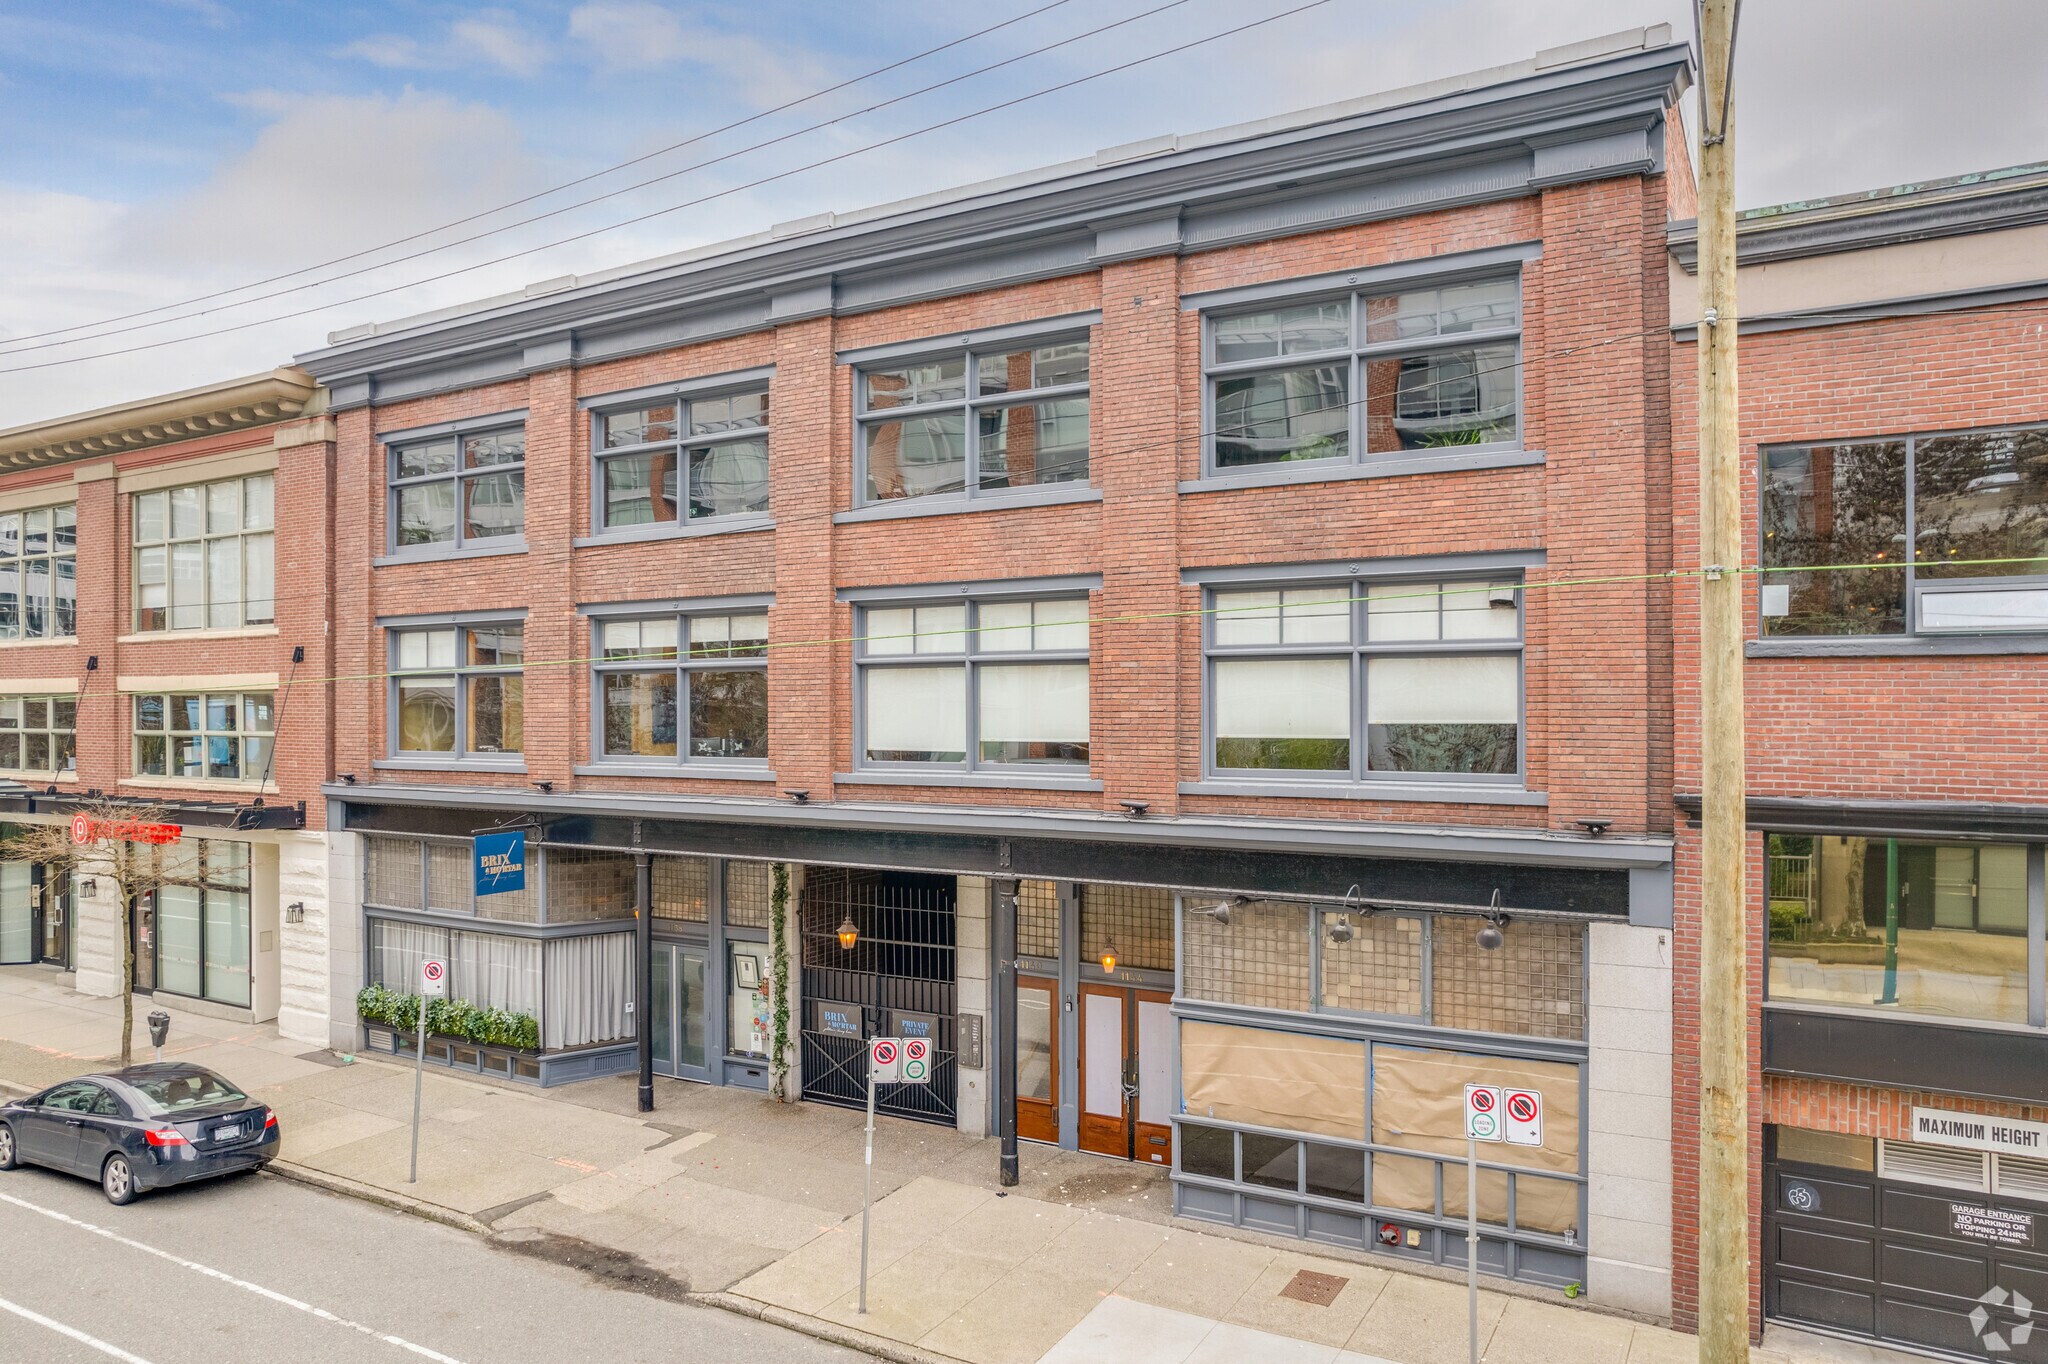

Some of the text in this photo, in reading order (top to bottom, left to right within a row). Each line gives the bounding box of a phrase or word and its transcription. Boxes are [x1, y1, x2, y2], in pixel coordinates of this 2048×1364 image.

[481, 854, 511, 868] BRIX
[824, 1011, 848, 1023] BRIX
[831, 1021, 857, 1031] MORTAR
[902, 1019, 930, 1030] PRIVATE
[904, 1027, 926, 1037] EVENT
[1920, 1117, 2040, 1147] MAXIMUM HEIGHT
[1952, 1204, 2032, 1223] GARAGE ENTRANCE
[1957, 1214, 2026, 1232] NO PARKING OR
[1954, 1222, 2030, 1240] STOPPING 24 HRS.
[1999, 1236, 2022, 1245] TOWED.
